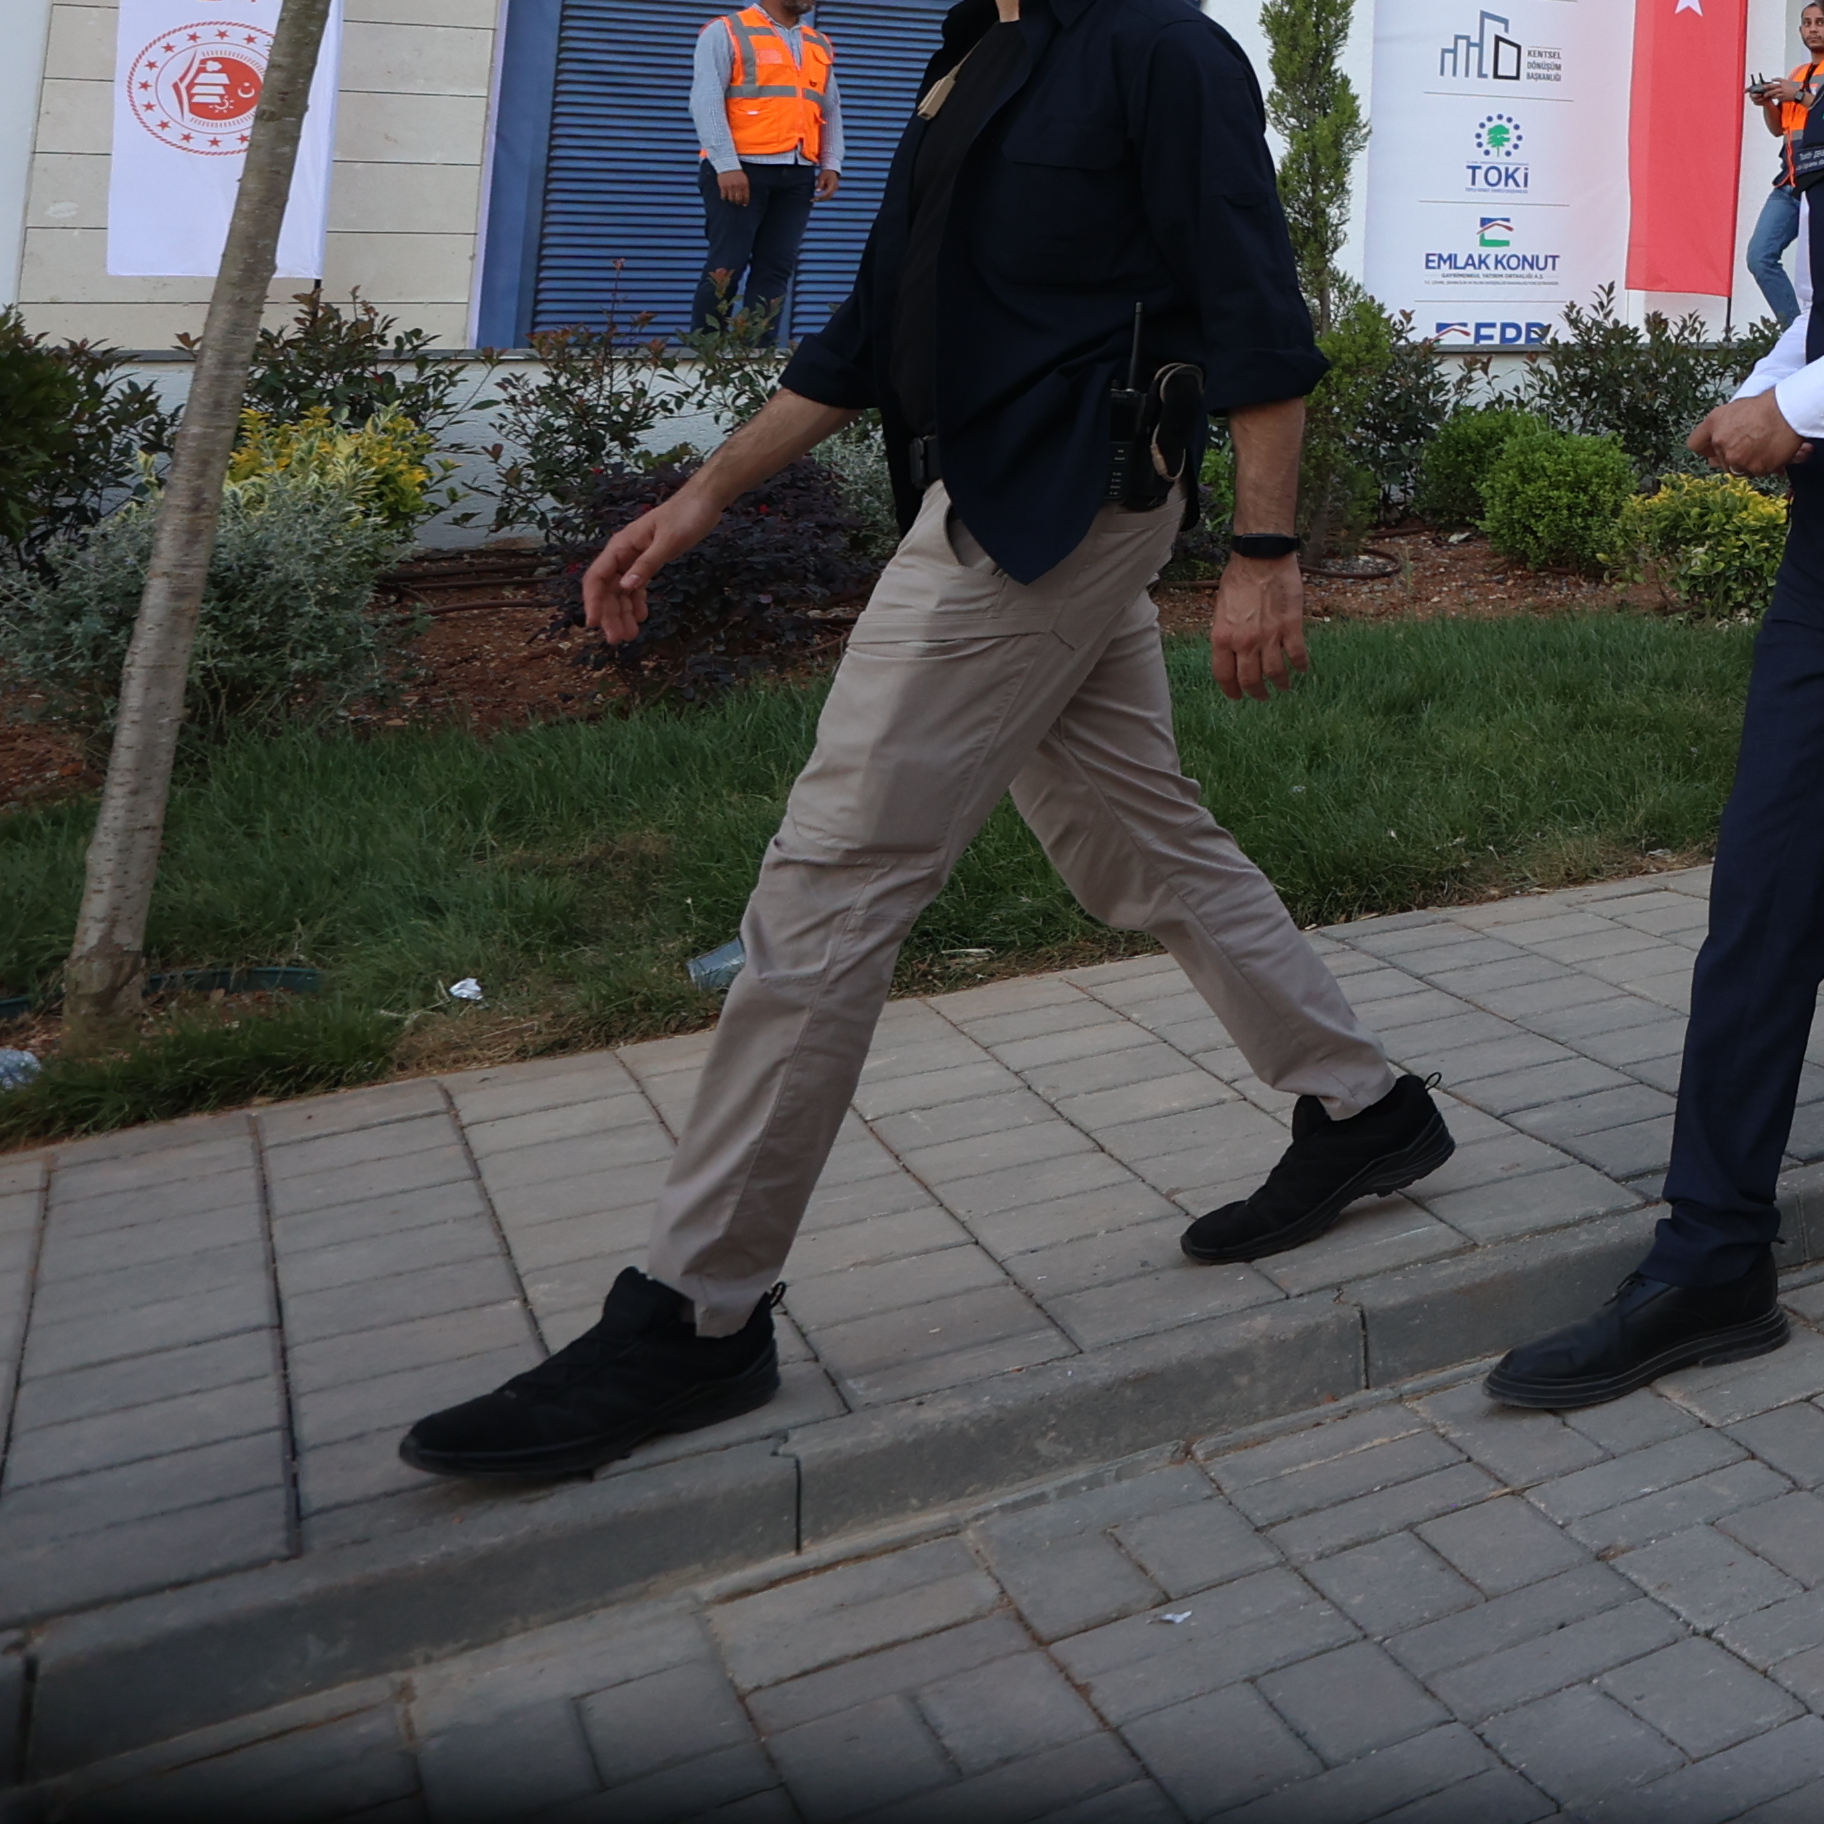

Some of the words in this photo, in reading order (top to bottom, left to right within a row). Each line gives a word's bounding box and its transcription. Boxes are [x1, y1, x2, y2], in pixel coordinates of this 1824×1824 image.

[1527, 49, 1562, 60] KENTSEL
[1526, 60, 1562, 72] DÖNÜŞÜM
[1424, 252, 1491, 271] EMLAK
[1493, 253, 1560, 271] KONUT
